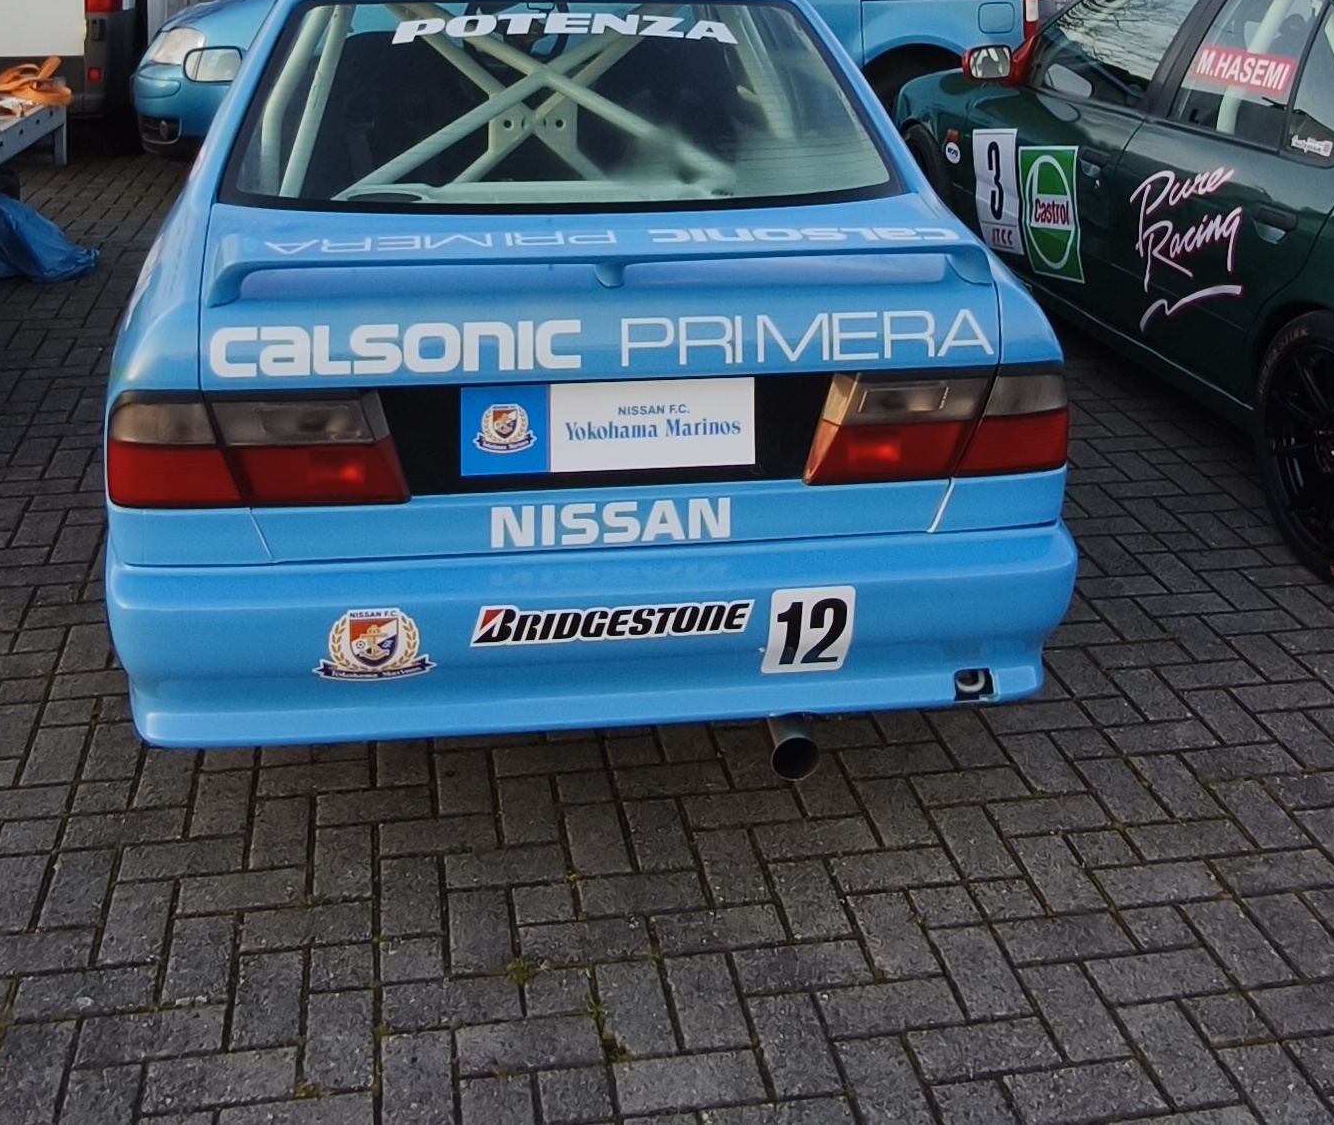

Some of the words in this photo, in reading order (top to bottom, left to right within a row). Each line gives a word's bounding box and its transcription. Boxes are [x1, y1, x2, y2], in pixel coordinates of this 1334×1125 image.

[391, 13, 739, 45] POTENZA
[1196, 49, 1291, 91] M.HASEMI
[986, 141, 1003, 221] 3
[1034, 198, 1070, 226] Castrol
[1130, 166, 1237, 257] Pure
[264, 229, 617, 255] PRIMERA
[1143, 206, 1243, 293] Racing
[620, 309, 997, 367] PRIMERA
[564, 421, 658, 442] Yokohama
[665, 418, 741, 438] Marinos
[618, 405, 665, 416] NISSAN
[669, 404, 690, 415] F.C.
[490, 497, 732, 549] NISSAN
[474, 601, 751, 644] BRIDGESTONE
[776, 597, 848, 666] 12
